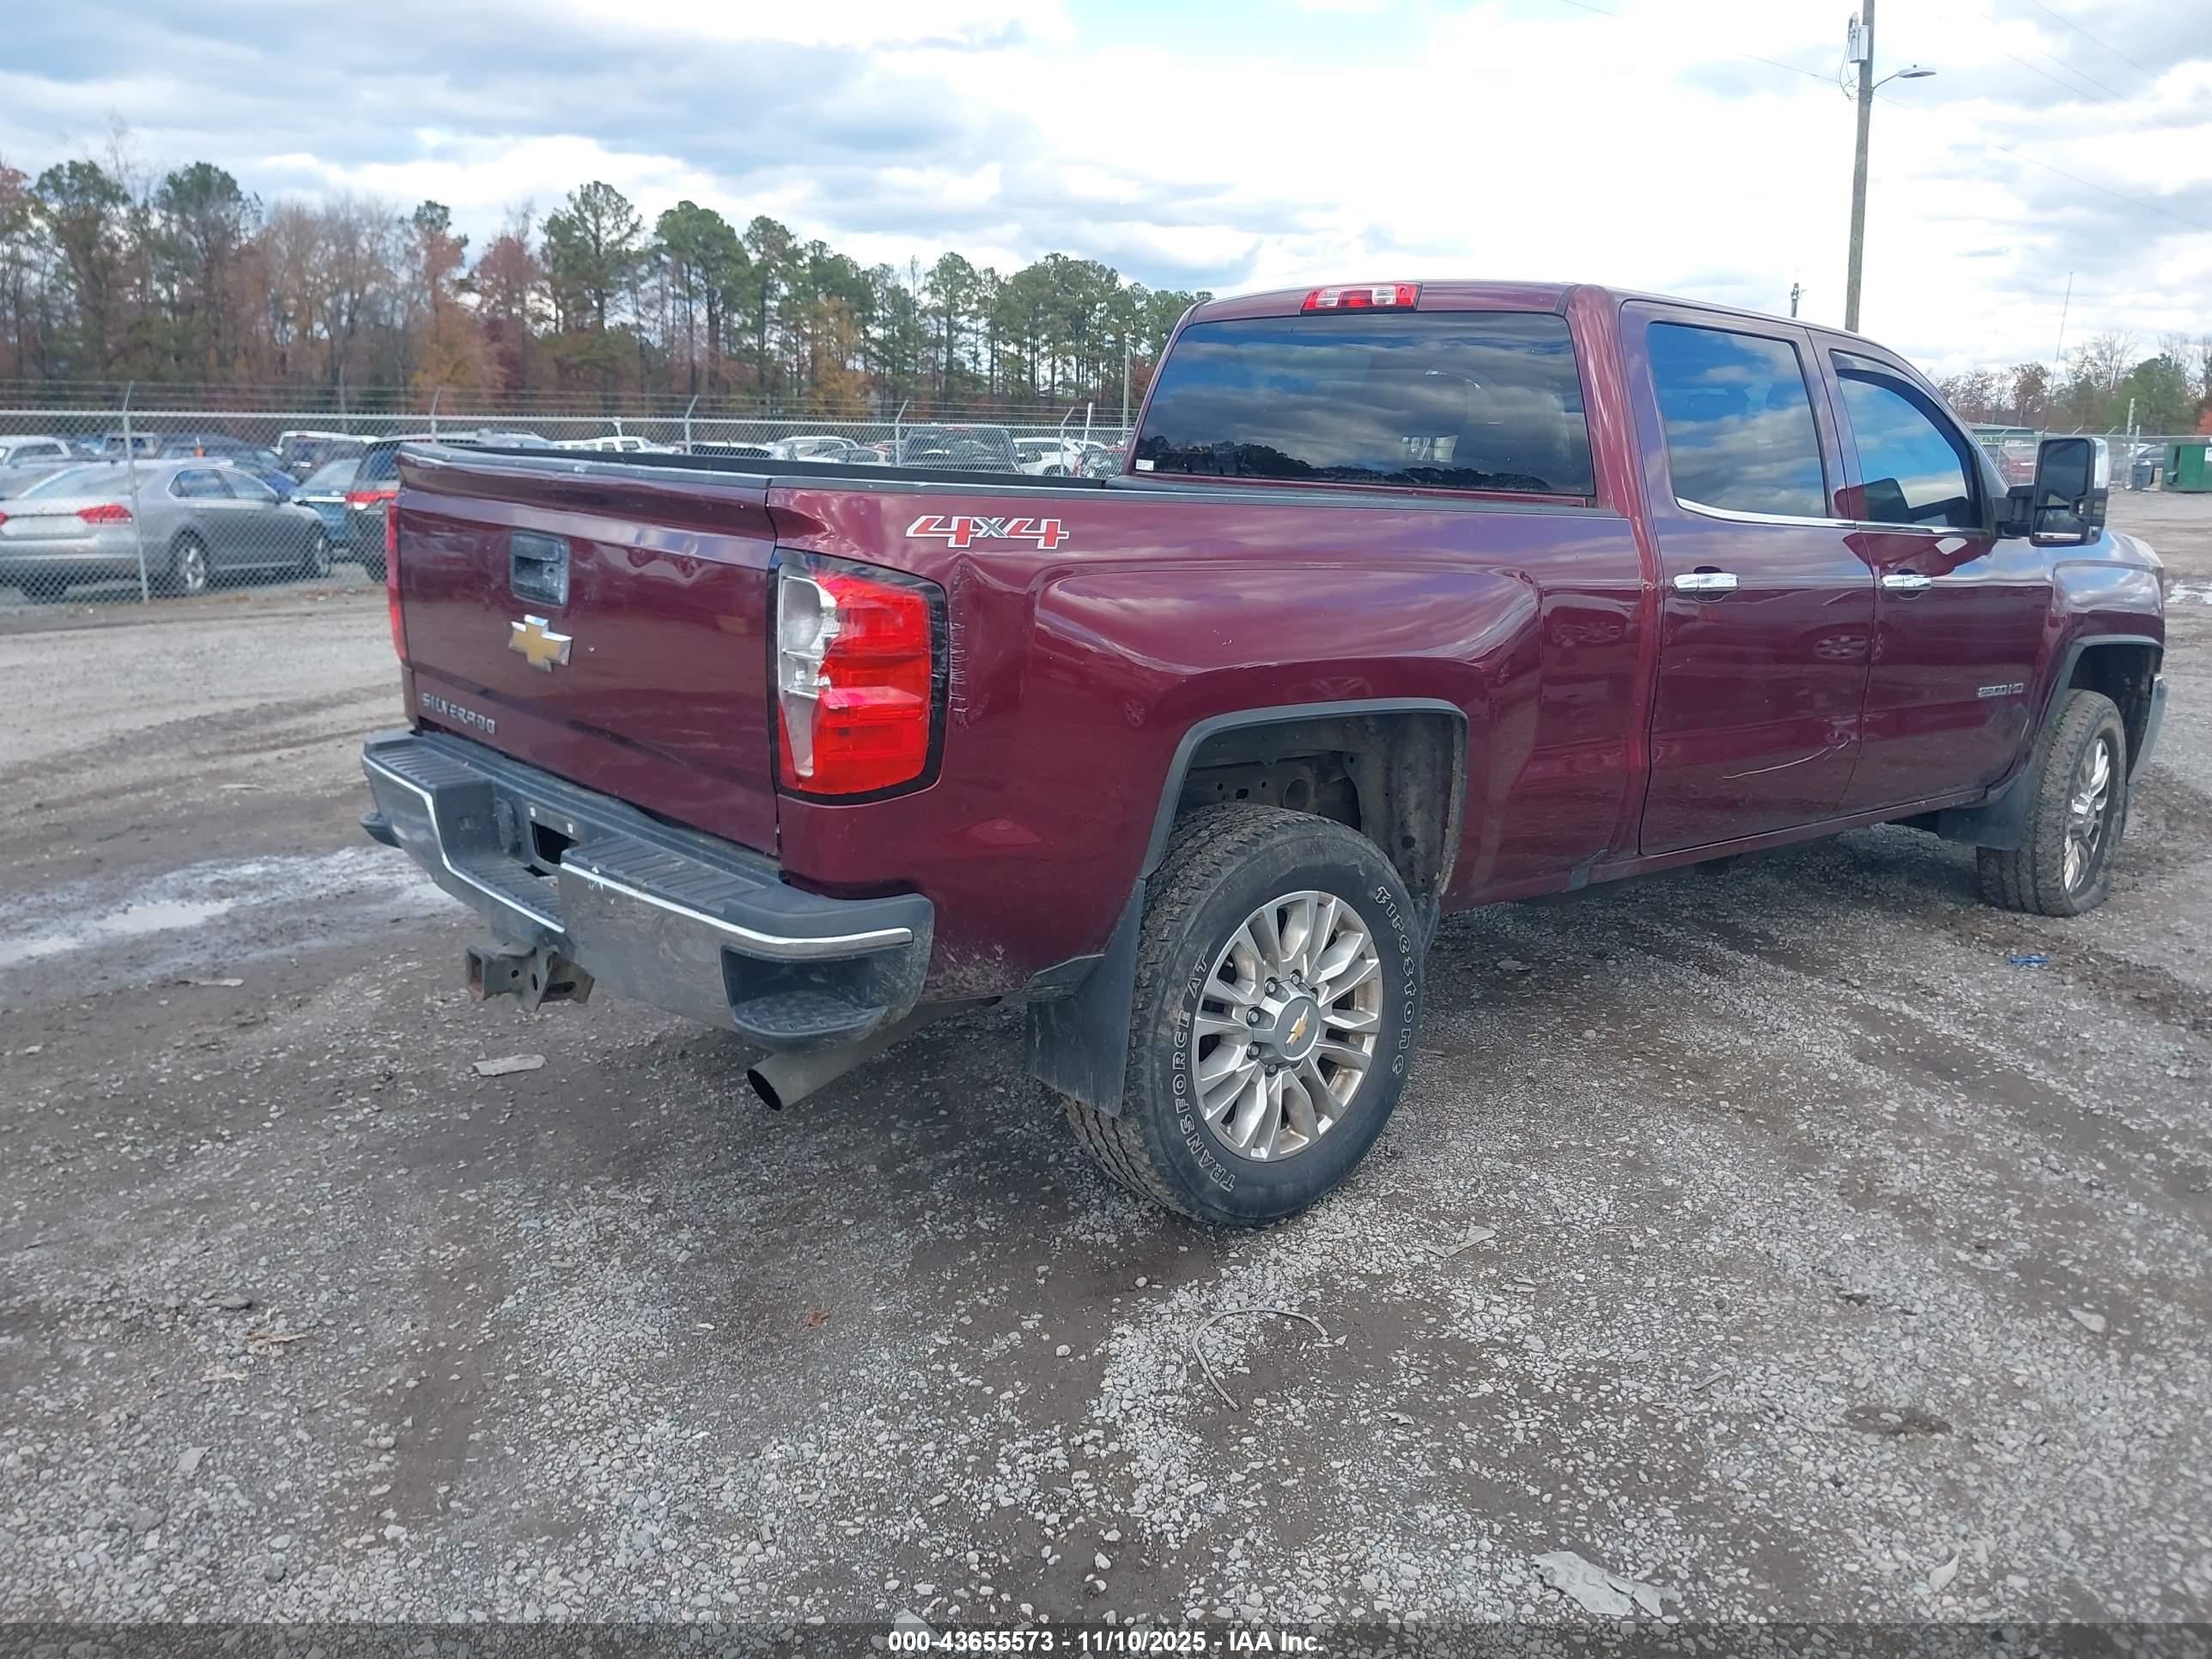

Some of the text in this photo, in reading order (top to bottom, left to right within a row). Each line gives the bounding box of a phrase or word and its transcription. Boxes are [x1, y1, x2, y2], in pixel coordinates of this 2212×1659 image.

[422, 692, 495, 734] SILVERADO
[1171, 945, 1236, 1193] TRANSFORCE AT
